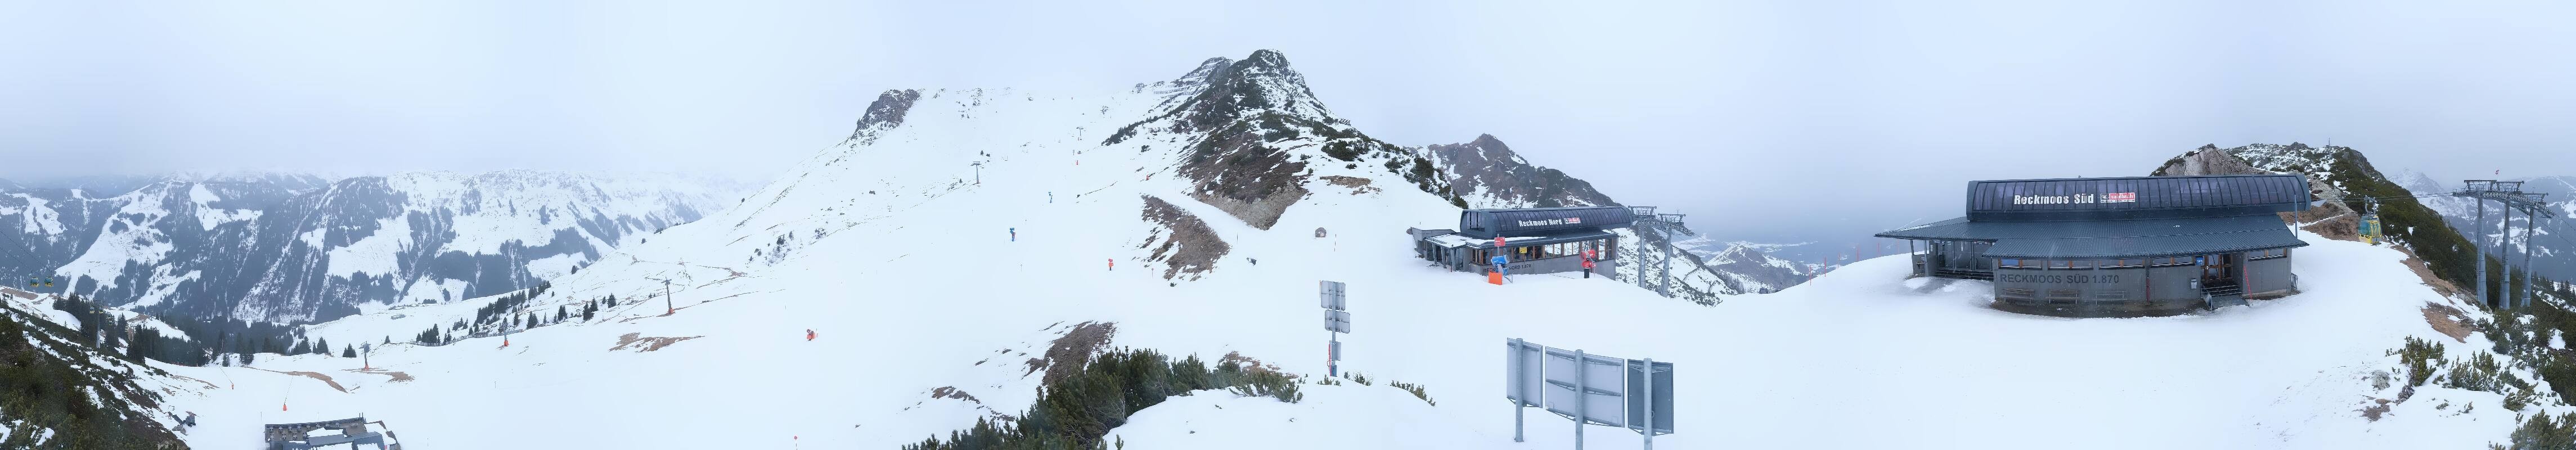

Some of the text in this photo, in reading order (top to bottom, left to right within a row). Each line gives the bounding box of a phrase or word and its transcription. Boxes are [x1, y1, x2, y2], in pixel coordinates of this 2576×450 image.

[2014, 193, 2094, 205] Reckmoos Süd
[2000, 273, 2119, 284] RECKMOOS SÜD 1.870
